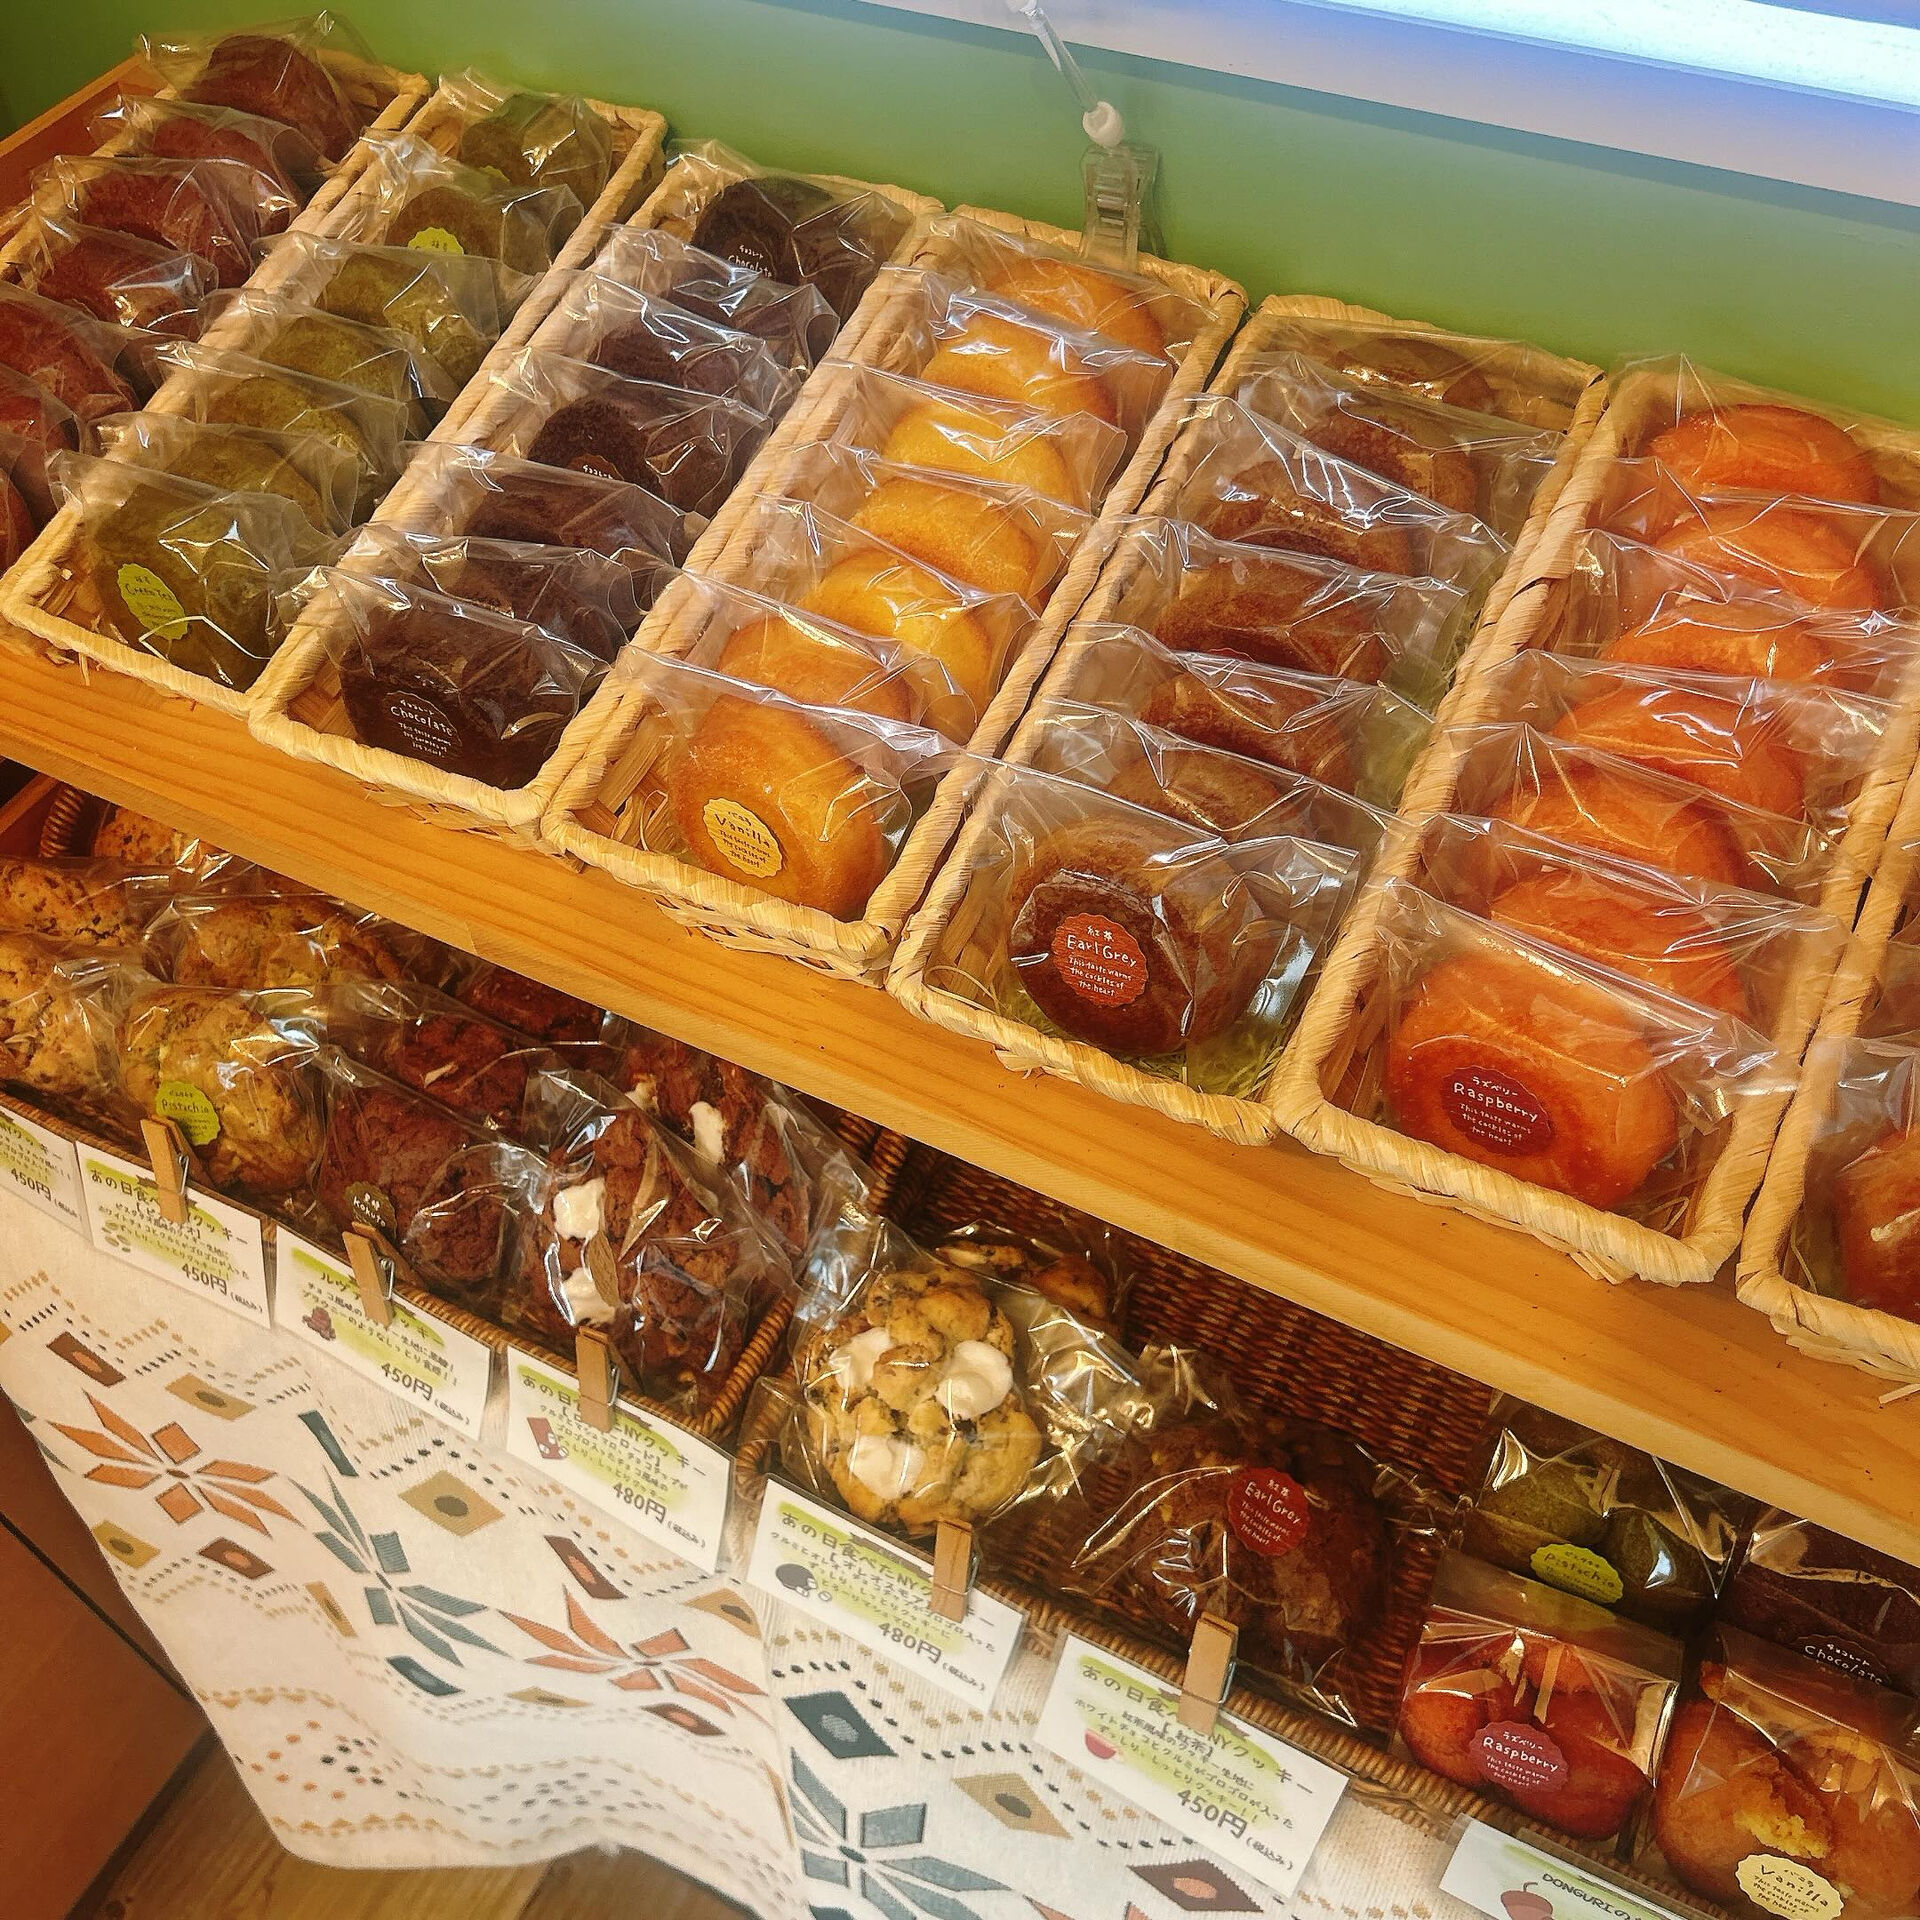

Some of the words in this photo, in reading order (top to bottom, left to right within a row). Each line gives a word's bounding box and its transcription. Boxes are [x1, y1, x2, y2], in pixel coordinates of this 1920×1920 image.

[391, 706, 453, 736] Chocolate
[714, 813, 770, 848] Vanilla
[728, 811, 751, 826] バニラ
[1087, 925, 1115, 942] 紅茶
[1067, 934, 1099, 954] Earl
[1102, 945, 1137, 968] Grey
[1069, 957, 1085, 967] This
[1085, 962, 1106, 974] taste
[1108, 969, 1132, 981] warms
[1070, 967, 1084, 976] the
[1085, 973, 1115, 987] cockles
[1116, 982, 1124, 990] of
[1077, 980, 1092, 990] the
[1454, 1082, 1539, 1123] Raspberry
[1472, 1076, 1518, 1096] ラズベリー
[162, 1098, 209, 1113] Pistachio
[11, 1168, 51, 1202] 450円
[181, 1262, 227, 1296] 450円
[381, 1361, 432, 1402] 450円
[613, 1481, 666, 1525] 480円
[1245, 1481, 1272, 1506] Earl
[1272, 1499, 1301, 1524] Grey
[1544, 1552, 1615, 1588] Pistachio
[878, 1621, 942, 1664] 480円
[1804, 1645, 1882, 1685] Chocolate
[1482, 1736, 1559, 1772] Raspberry
[1503, 1731, 1544, 1750] ラズベリー
[1176, 1789, 1248, 1839] 450円
[1761, 1864, 1829, 1907] Vanilla
